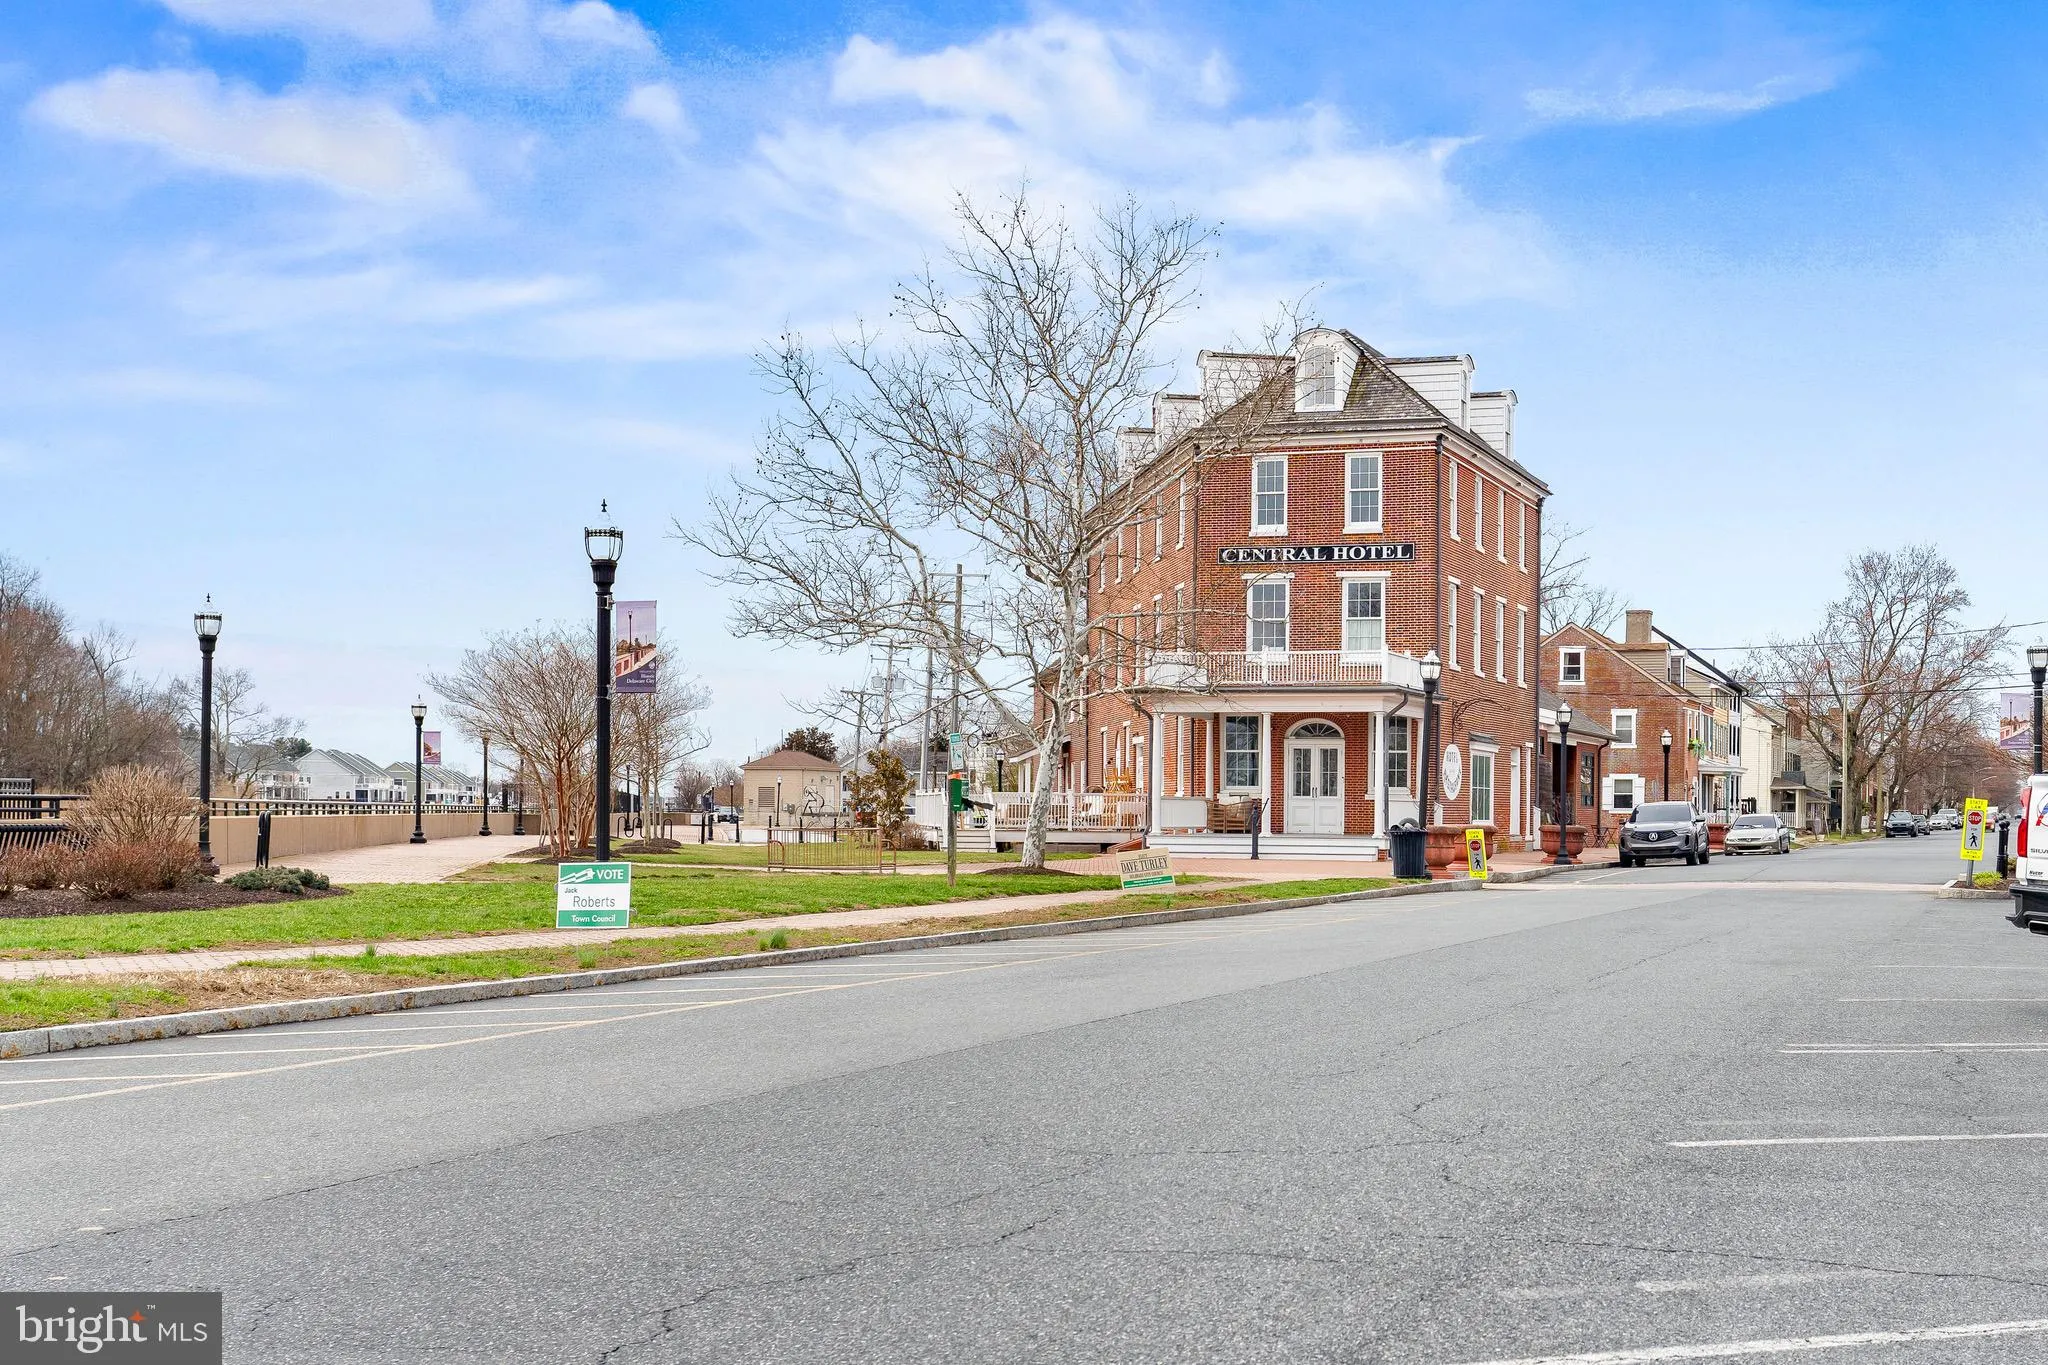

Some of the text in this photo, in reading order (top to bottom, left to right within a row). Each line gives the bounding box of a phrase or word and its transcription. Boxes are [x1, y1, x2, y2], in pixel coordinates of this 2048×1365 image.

[1221, 545, 1410, 562] CENTRAL HOTEL
[1120, 860, 1138, 873] DAVE
[1139, 856, 1168, 871] TURLEY
[596, 869, 624, 880] VOTE
[573, 895, 616, 908] Roberts
[571, 913, 616, 923] Town Council
